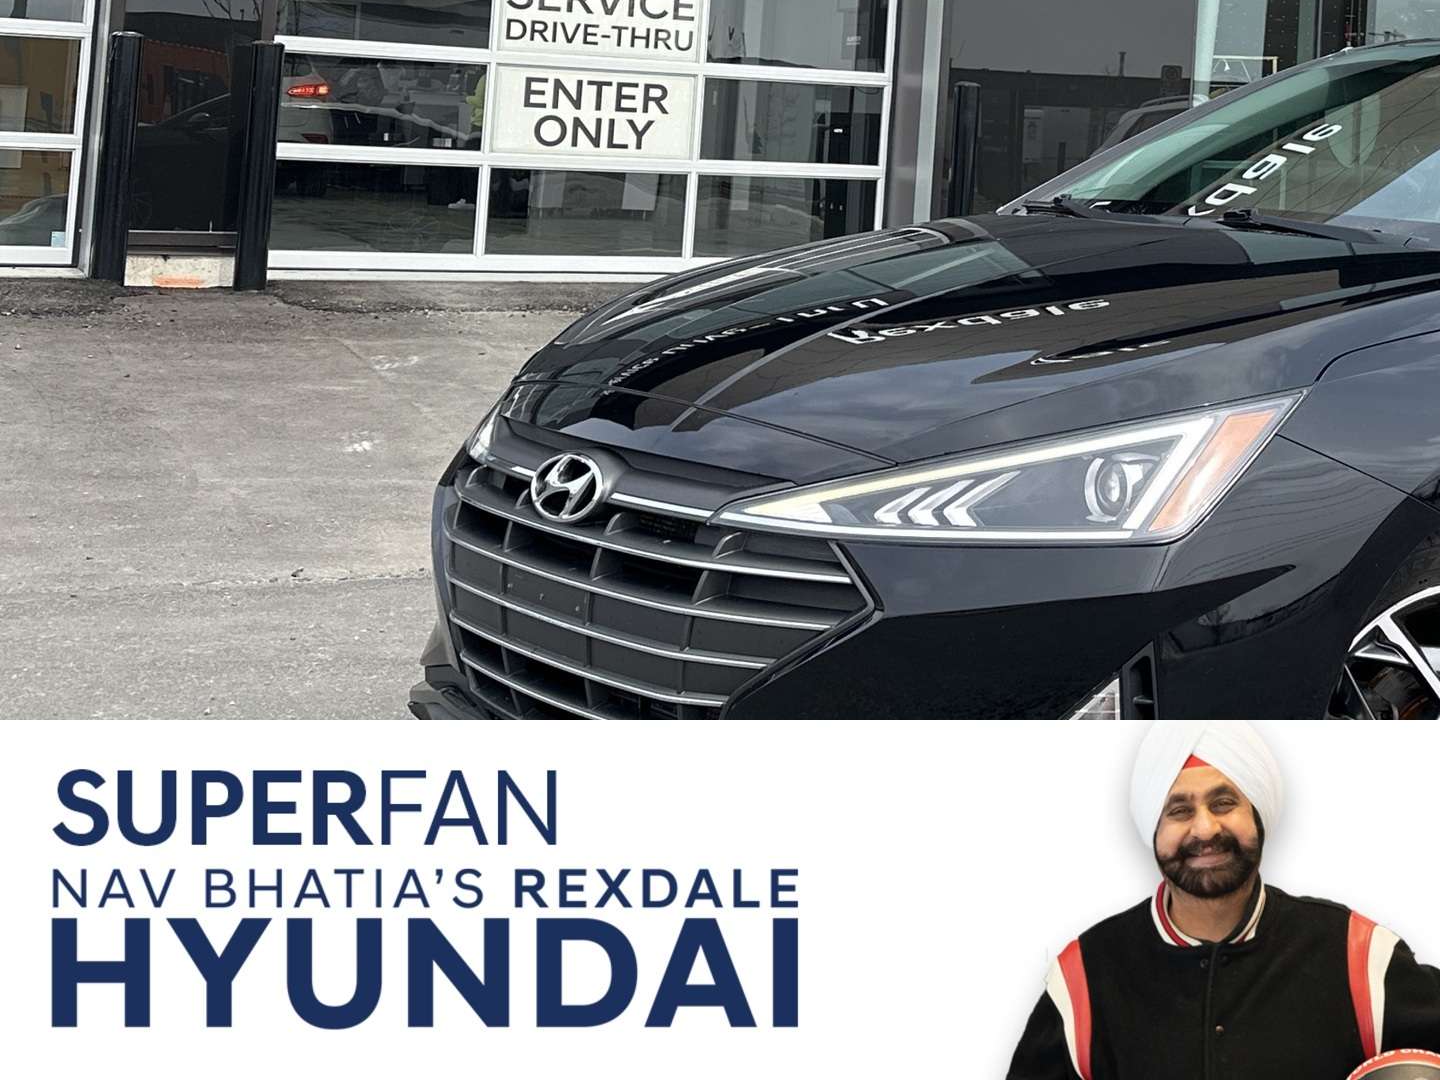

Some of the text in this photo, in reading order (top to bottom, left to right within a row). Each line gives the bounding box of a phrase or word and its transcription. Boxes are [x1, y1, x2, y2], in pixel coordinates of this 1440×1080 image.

[505, 18, 694, 52] DRIVE-THRU
[523, 76, 669, 115] ENTER
[534, 115, 655, 150] ONLY
